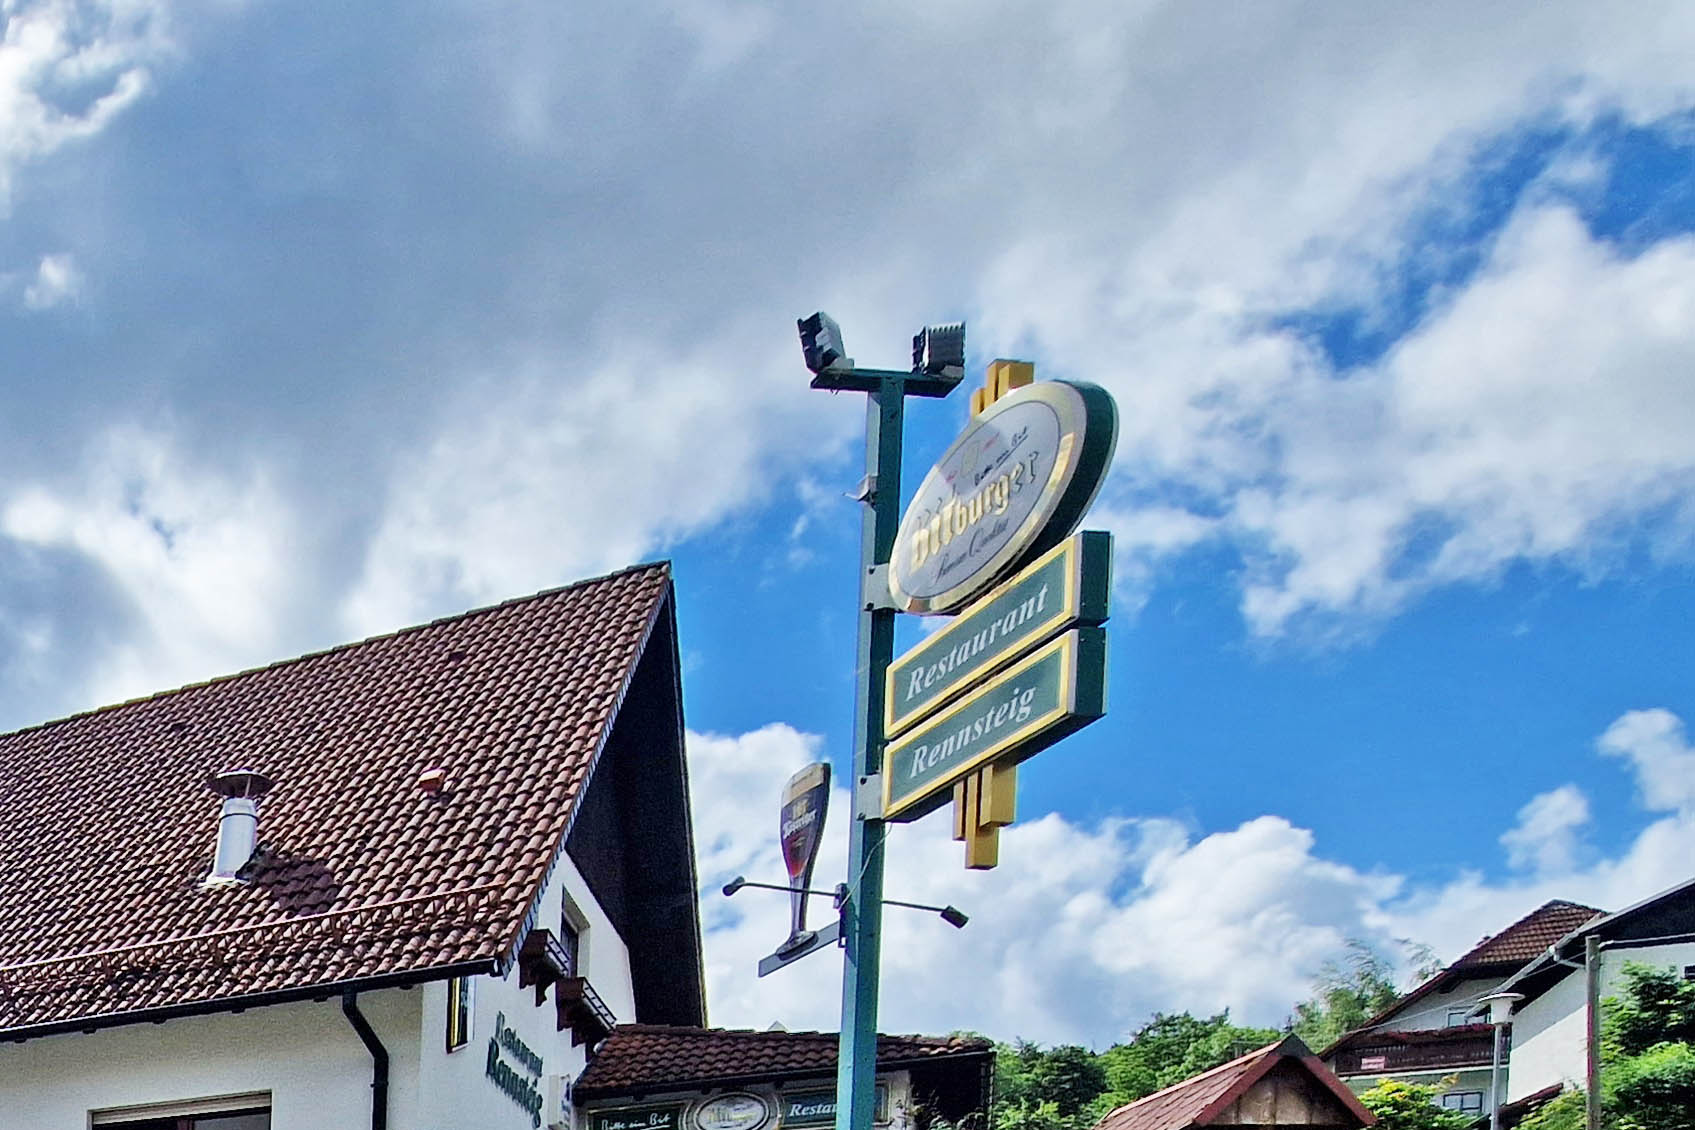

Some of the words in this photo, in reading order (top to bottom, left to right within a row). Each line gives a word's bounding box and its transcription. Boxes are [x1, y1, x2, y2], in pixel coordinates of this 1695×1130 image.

[906, 581, 1049, 701] Restaurant
[909, 686, 1037, 779] Rennsteig
[789, 1103, 839, 1117] Resta
